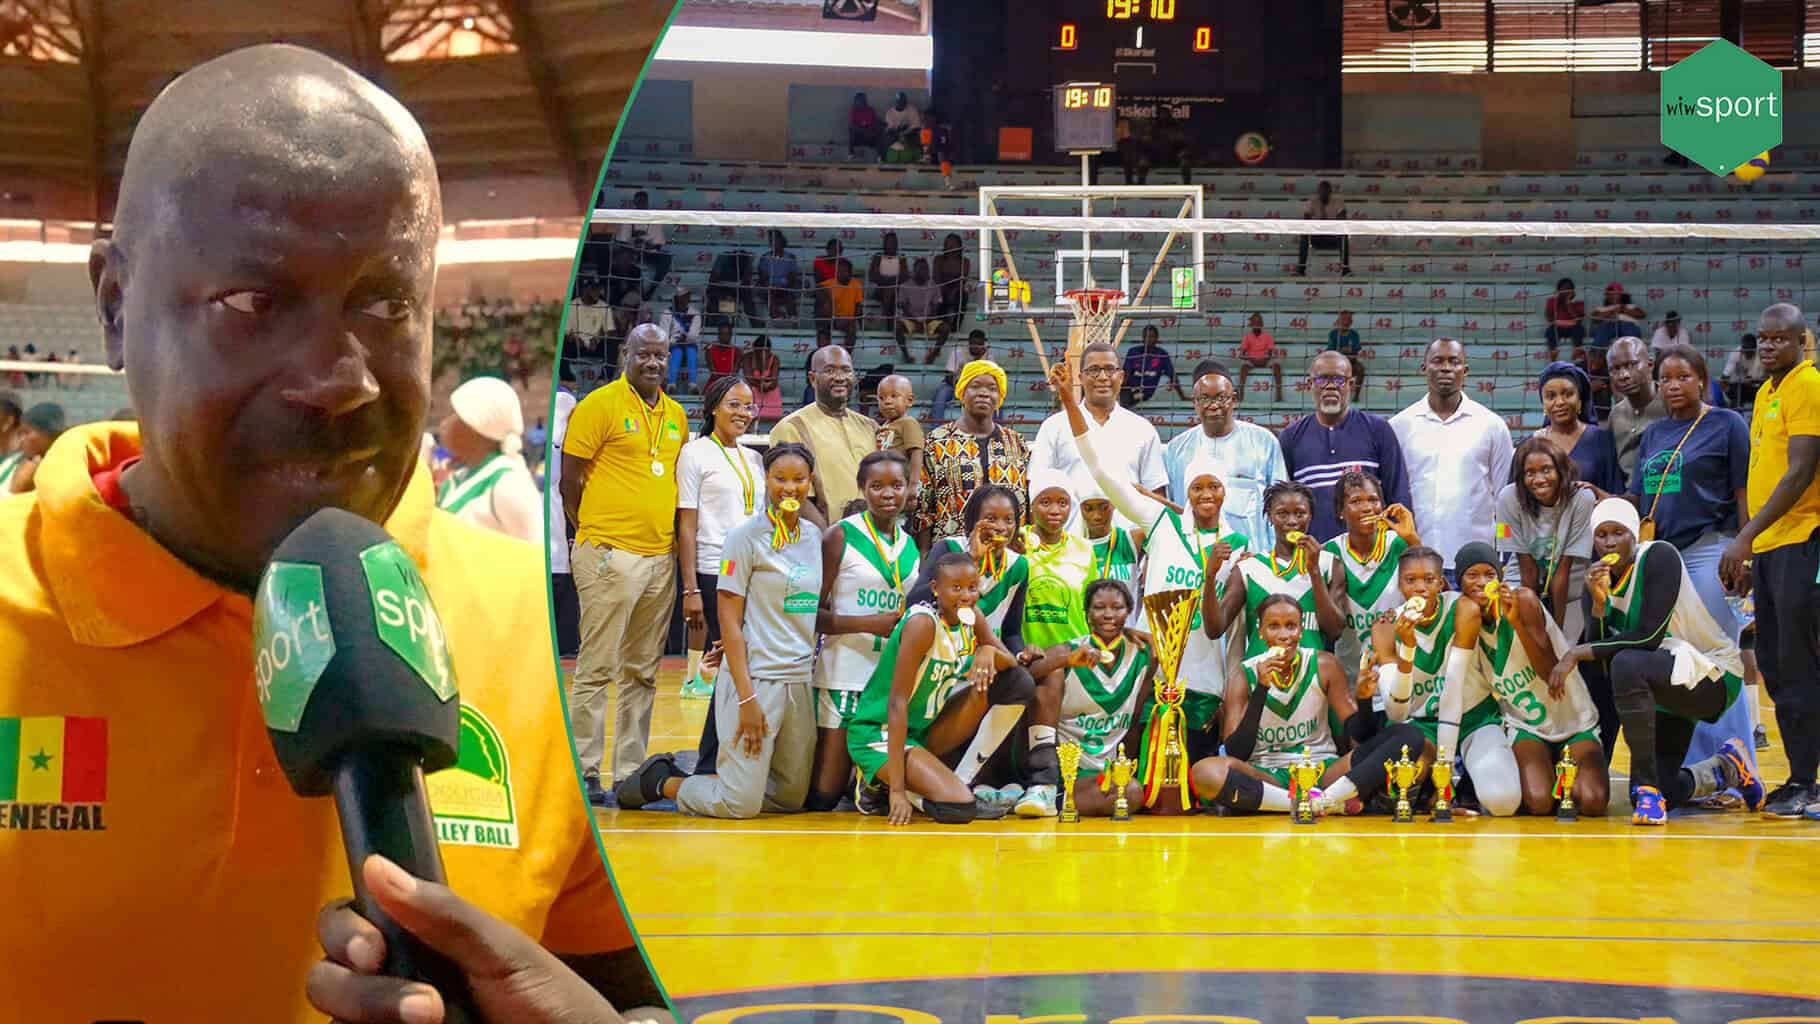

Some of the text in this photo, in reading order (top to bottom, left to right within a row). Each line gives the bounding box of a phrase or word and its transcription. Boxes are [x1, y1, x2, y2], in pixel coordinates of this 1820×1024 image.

[1061, 25, 1076, 48] 0
[1196, 27, 1211, 50] 0
[1065, 88, 1111, 109] 19:10
[1215, 287, 1233, 298] 40
[1260, 287, 1278, 299] 41
[1303, 287, 1320, 298] 42
[1347, 287, 1363, 298] 43
[1289, 318, 1308, 329] 40
[1375, 318, 1393, 329] 42
[1252, 381, 1270, 392] 33
[1511, 690, 1548, 727] 3
[1256, 718, 1318, 745] SOCOCIM
[474, 824, 513, 846] BALL
